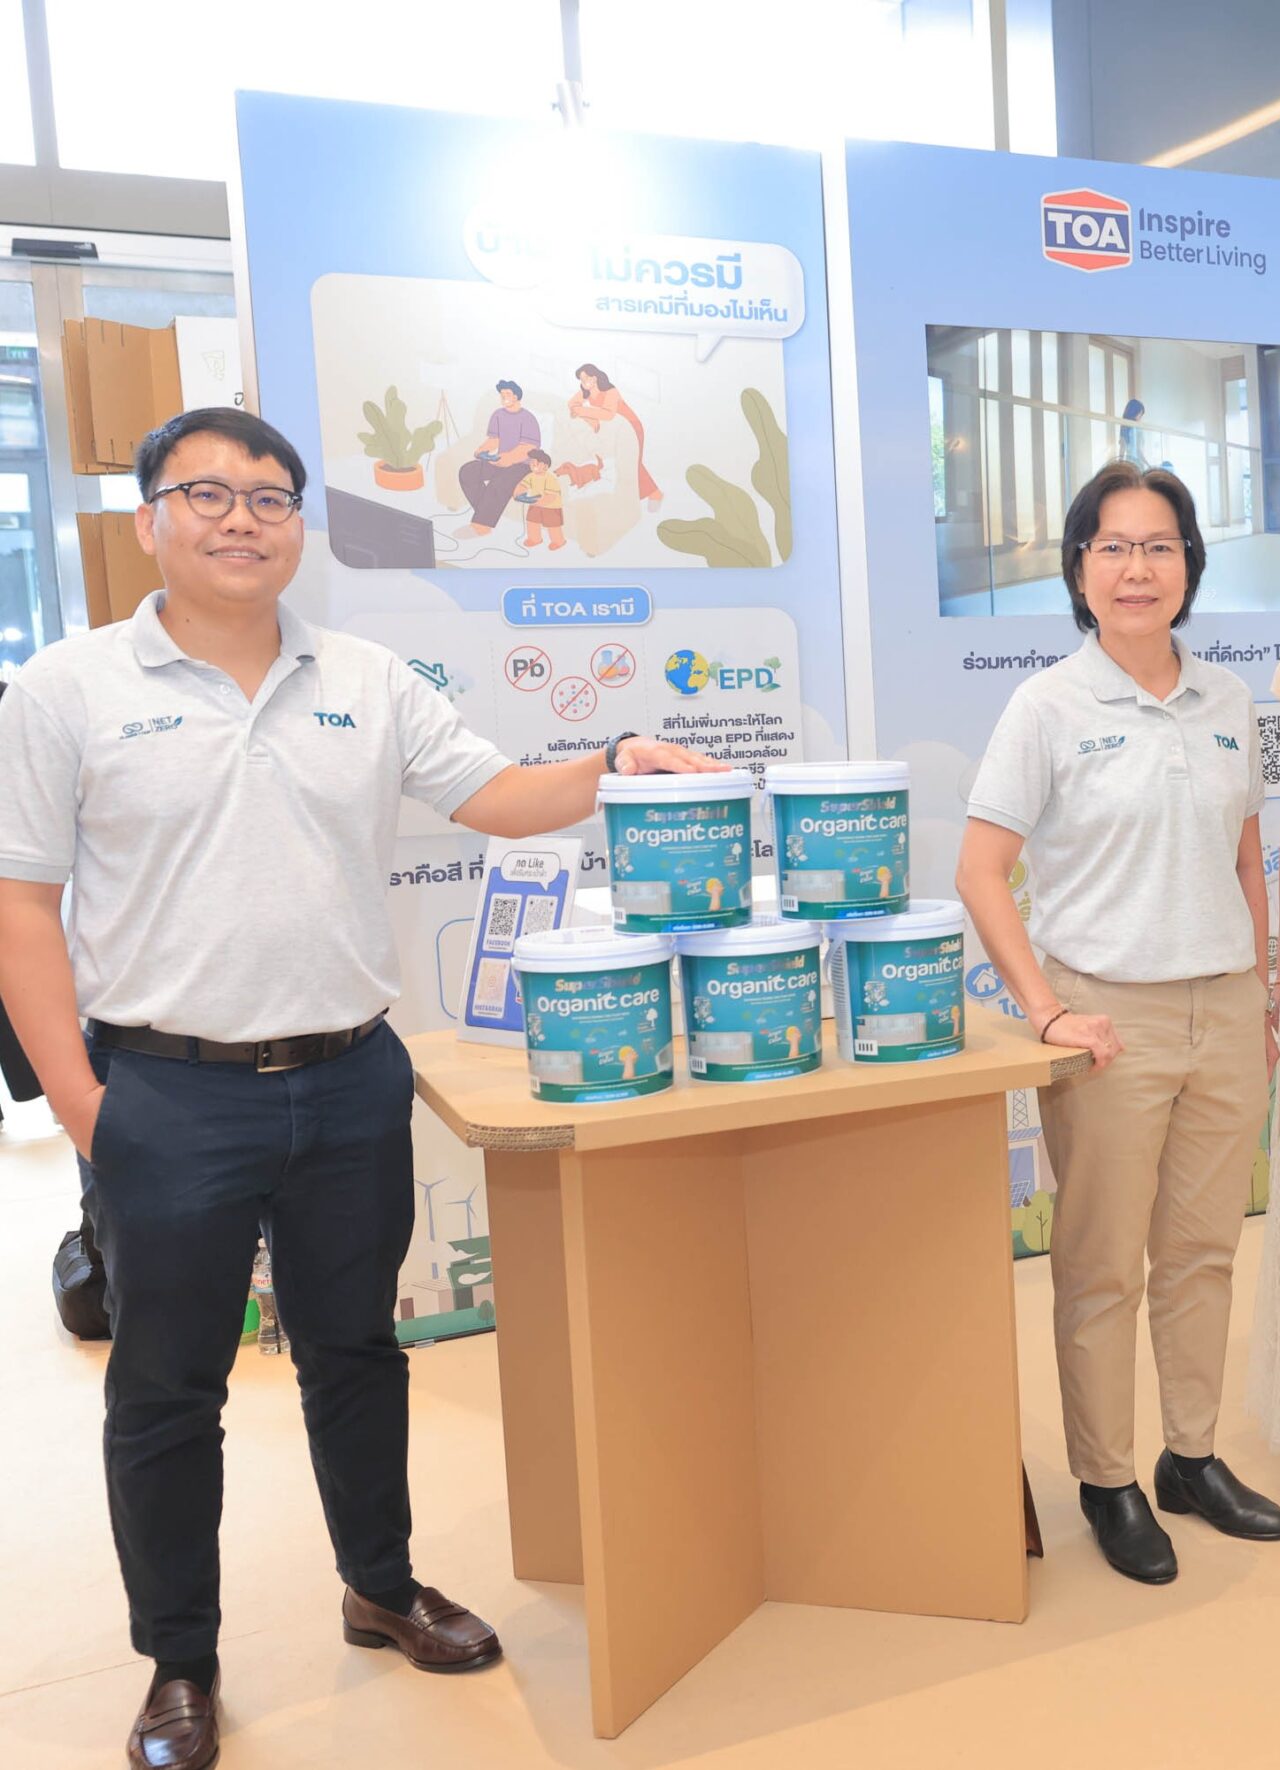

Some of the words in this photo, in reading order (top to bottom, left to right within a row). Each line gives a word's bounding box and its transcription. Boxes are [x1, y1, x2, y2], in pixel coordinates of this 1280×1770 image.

[1047, 211, 1127, 250] TOA
[1138, 207, 1231, 242] Inspire
[1140, 240, 1204, 264] Better
[1205, 245, 1267, 276] Living
[521, 593, 536, 618] ที่
[542, 602, 587, 618] TOA
[592, 598, 635, 617] เรามี
[512, 658, 545, 678] Pb
[719, 668, 774, 691] EPD
[152, 716, 172, 726] NET
[313, 712, 356, 728] TOA
[726, 733, 751, 743] EPD
[755, 726, 794, 742] ที่แสดง
[1213, 734, 1239, 750] TOA
[708, 822, 744, 840] care
[882, 814, 908, 830] care
[528, 858, 544, 868] Like
[791, 972, 818, 990] care
[619, 988, 660, 1008] care
